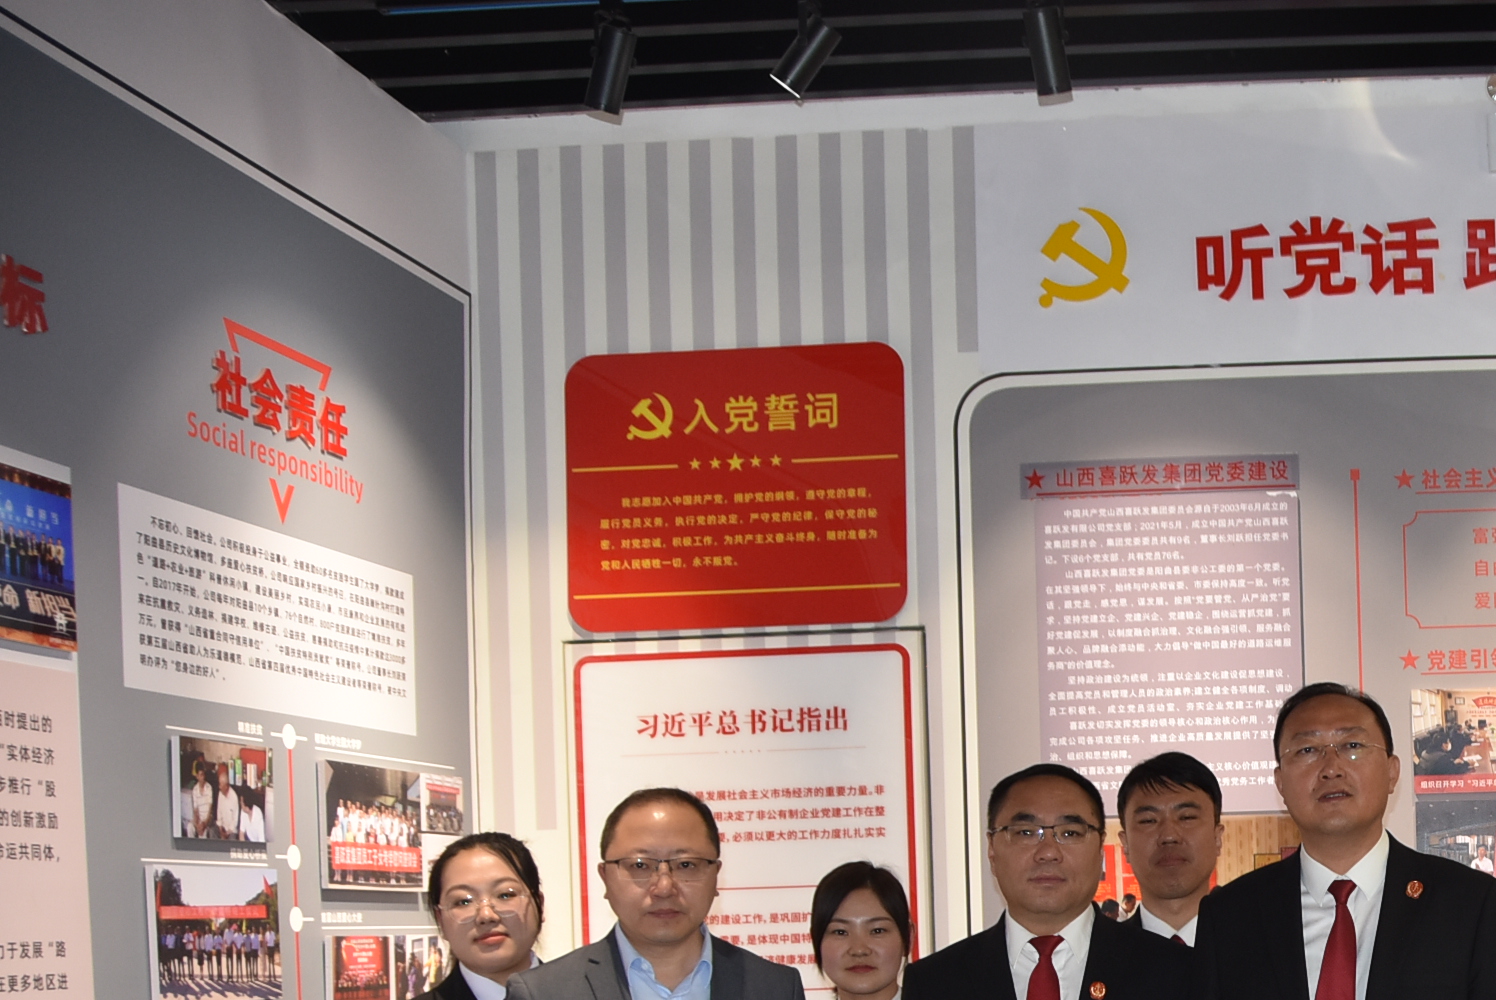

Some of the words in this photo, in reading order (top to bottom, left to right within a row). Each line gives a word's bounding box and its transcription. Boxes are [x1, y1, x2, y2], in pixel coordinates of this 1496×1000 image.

[1196, 214, 1440, 302] 听党话
[211, 348, 349, 459] 社会责任
[683, 392, 840, 435] 入党誓词
[187, 411, 247, 458] Social
[249, 435, 364, 504] responsibility
[1055, 460, 1289, 488] 山西喜跃发集团党委建设
[0, 582, 20, 611] 命
[636, 706, 849, 739] 习近平总书记指出
